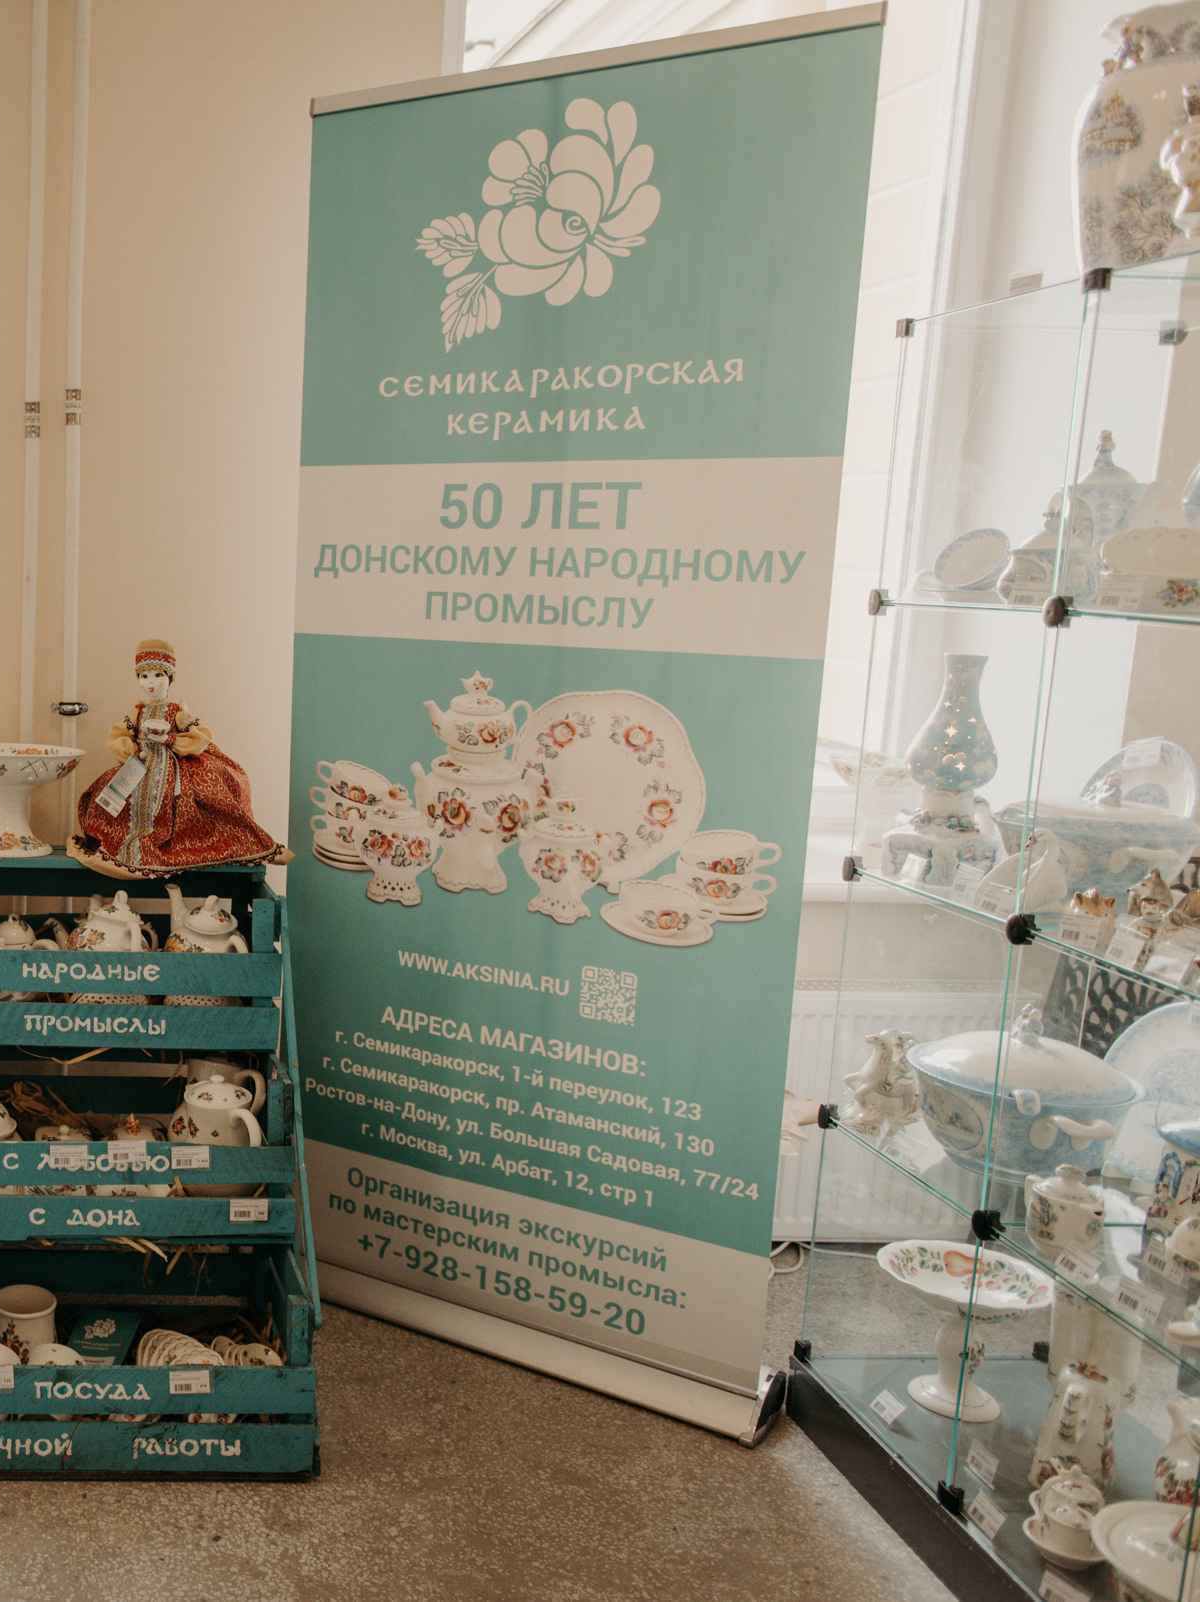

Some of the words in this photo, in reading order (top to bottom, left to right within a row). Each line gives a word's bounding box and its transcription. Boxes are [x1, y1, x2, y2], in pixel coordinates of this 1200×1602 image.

[378, 358, 744, 399] СЕМИКАРАКОРСКАЯ
[447, 406, 645, 441] КЕРАМИКА
[439, 482, 503, 531] 50
[521, 481, 643, 531] ЛЕТ
[314, 544, 517, 579] ДОНСКОМУ
[528, 546, 806, 588] НАРОДНОМУ
[424, 590, 655, 629] ПРОМЫСЛУ
[22, 962, 160, 984] НАРОДНЫЕ
[397, 950, 570, 996] WWW.AKSINIA.RU
[24, 1014, 166, 1036] ПРОМЫСЛЫ
[380, 1005, 474, 1044] АДРЕСА
[480, 1026, 648, 1077] МАГАЗИНОВ:
[335, 1030, 348, 1045] г.
[353, 1031, 506, 1083] Семикаракорск,
[511, 1065, 544, 1089] 1-й
[550, 1076, 654, 1114] переулок,
[661, 1096, 702, 1121] 123
[322, 1056, 336, 1071] г.
[340, 1057, 490, 1110] Семикаракорск,
[495, 1094, 526, 1117] пр.
[530, 1101, 666, 1149] Атаманский,
[674, 1132, 715, 1157] 130
[3, 1153, 20, 1170] С
[305, 1077, 451, 1132] Ростов-на-Дону,
[456, 1117, 484, 1136] ул.
[490, 1121, 581, 1160] Большая
[586, 1144, 686, 1187] Садовая,
[693, 1169, 760, 1201] 77/24
[361, 1122, 374, 1137] г.
[379, 1124, 453, 1162] Москва,
[458, 1148, 486, 1168] ул.
[491, 1153, 558, 1187] Арбат,
[564, 1170, 595, 1197] 12,
[600, 1184, 638, 1207] стр
[644, 1189, 653, 1207] 1
[29, 1208, 46, 1226] С
[66, 1208, 141, 1227] ДОНА
[347, 1167, 511, 1231] Организация
[517, 1216, 667, 1272] экскурсий
[328, 1193, 357, 1215] по
[362, 1202, 520, 1262] мастерским
[527, 1249, 687, 1309] промысла:
[357, 1232, 646, 1336] +7-928-158-59-20
[34, 1380, 151, 1401] ПОСУДА
[132, 1436, 241, 1459] РАБОТЫ
